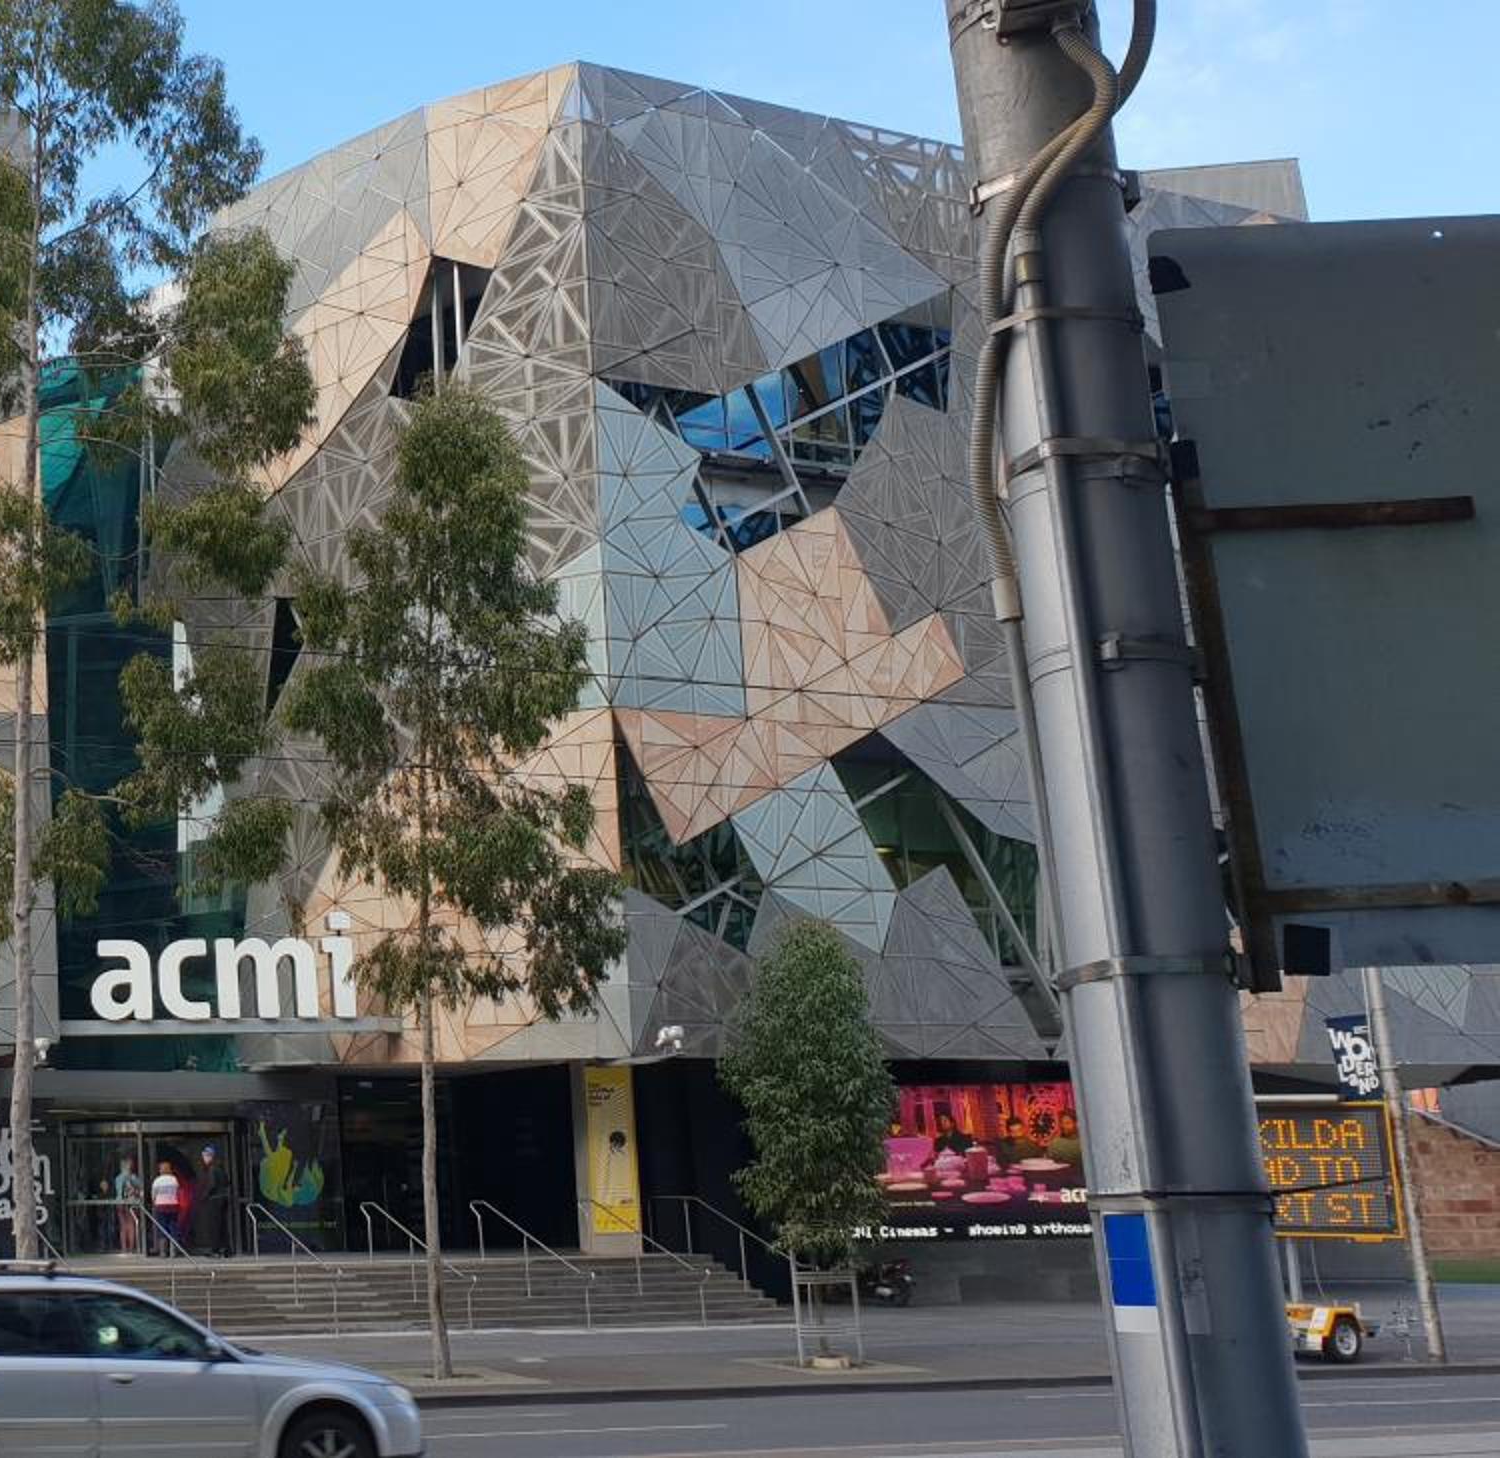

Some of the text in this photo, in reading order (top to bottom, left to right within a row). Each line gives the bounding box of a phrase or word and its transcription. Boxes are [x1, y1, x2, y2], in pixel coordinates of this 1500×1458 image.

[90, 911, 358, 1021] acmi
[1326, 1192, 1376, 1224] ST
[880, 1225, 938, 1239] Cinemas
